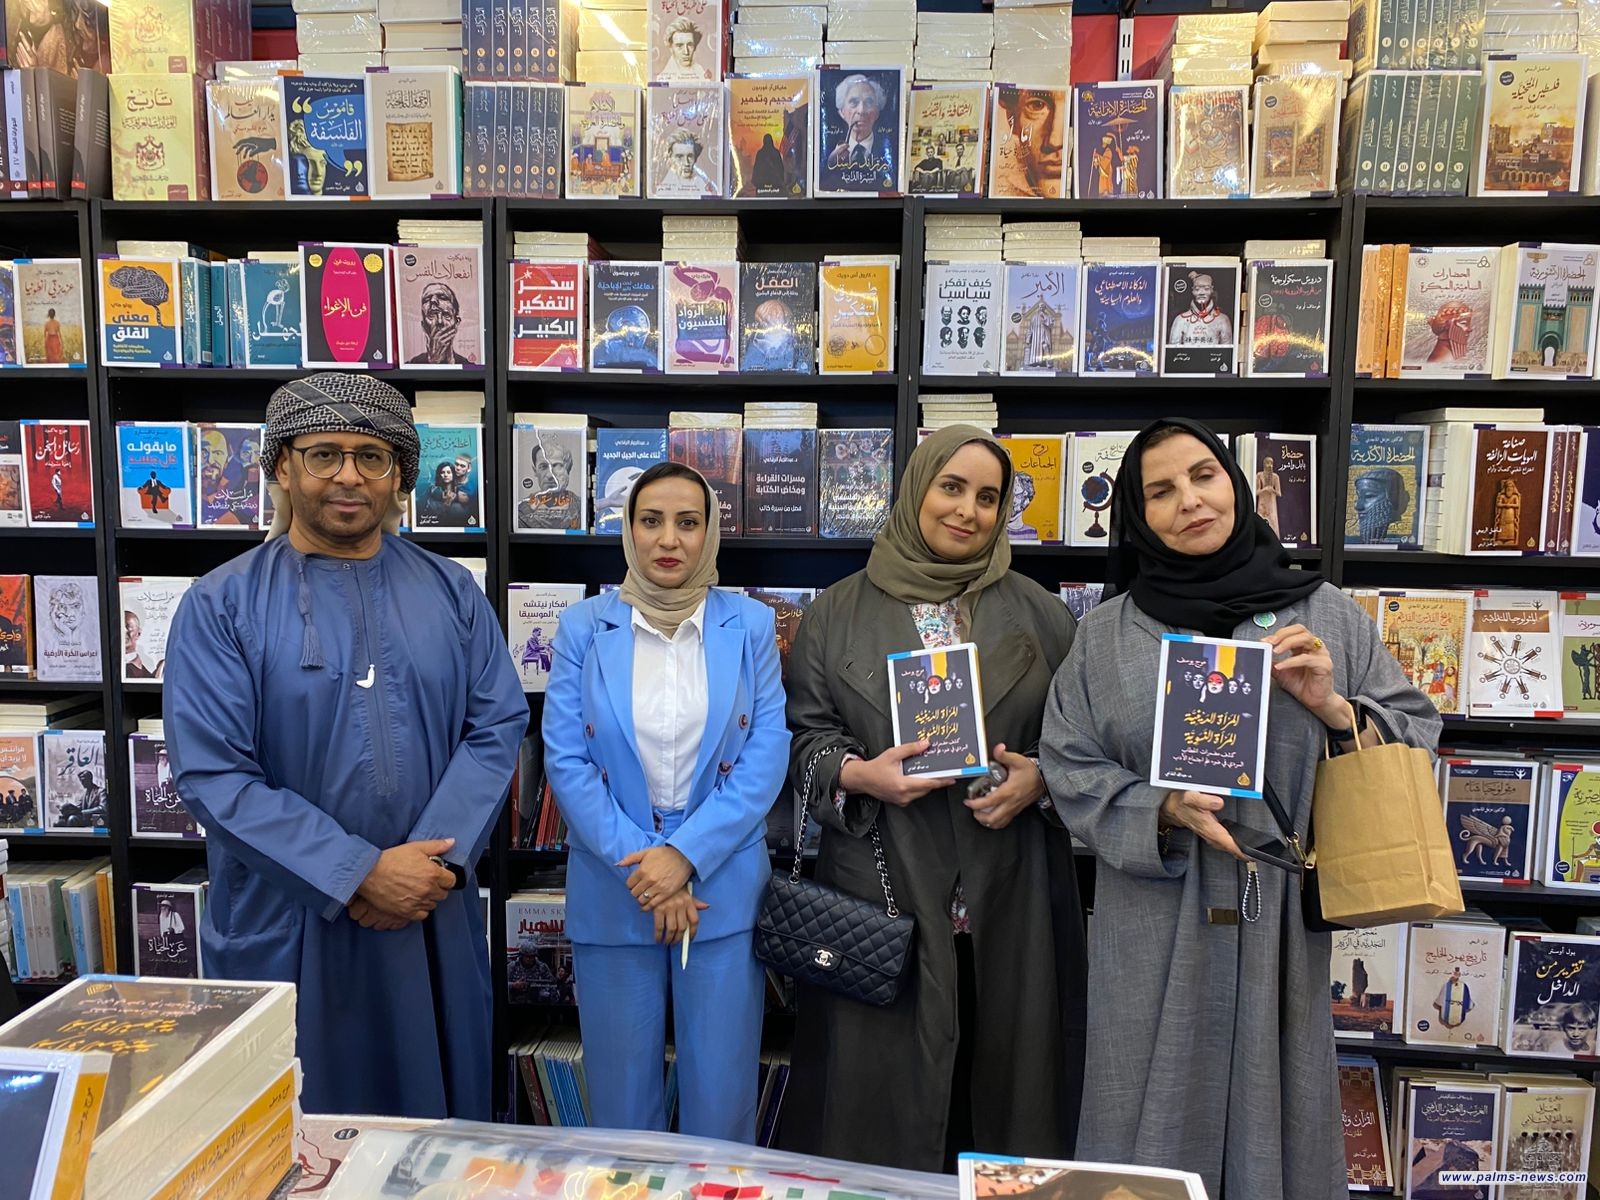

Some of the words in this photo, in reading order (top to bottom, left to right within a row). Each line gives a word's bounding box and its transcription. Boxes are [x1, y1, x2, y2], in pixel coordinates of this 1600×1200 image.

[1512, 76, 1538, 100] المتخيلة
[1527, 78, 1561, 103] فلسطين
[127, 88, 173, 112] تاريخ
[741, 95, 768, 105] وتدمير
[1119, 99, 1148, 113] الحضارة
[316, 98, 354, 119] قاموس
[311, 119, 362, 141] الفلسفة
[1300, 275, 1321, 286] دروس
[1433, 267, 1471, 281] الحضارات
[517, 279, 575, 294] سحر
[755, 277, 798, 291] العقل
[943, 278, 967, 290] تفكر
[969, 278, 992, 290] كيف
[1021, 271, 1065, 299] الأمير
[1095, 279, 1129, 295] الاصطناعي
[1129, 276, 1148, 291] الذكاء
[1420, 281, 1454, 293] المبكرة
[324, 297, 350, 317] الإغواء
[349, 303, 368, 318] فن
[517, 294, 575, 314] التفكير
[678, 305, 704, 317] الرواد
[112, 311, 149, 324] معنى
[678, 316, 726, 331] النفسيون
[112, 327, 149, 342] القلق
[517, 318, 575, 338] الكبير
[35, 436, 57, 460] السجن
[1032, 443, 1049, 456] روح
[1502, 436, 1527, 450] صناعة
[54, 441, 81, 461] رسائل
[602, 451, 621, 460] الجديد
[620, 451, 636, 460] الجيل
[635, 452, 650, 460] على
[650, 451, 661, 459] ثناء
[1281, 444, 1304, 459] حضارة
[1350, 446, 1385, 464] الأكدية
[1385, 446, 1415, 463] الحضارة
[1486, 448, 1509, 464] الزائفة
[1507, 450, 1538, 466] الهويات
[161, 454, 177, 466] كل
[1020, 456, 1056, 469] الجماعات
[756, 473, 781, 484] القراءة
[781, 475, 806, 484] مسرات
[214, 488, 253, 502] مراسلات
[756, 484, 781, 497] الكتابة
[781, 486, 806, 497] ومخاض
[137, 591, 175, 605] مراسلات
[523, 601, 548, 610] نيتشه
[549, 600, 568, 609] أفكار
[518, 610, 554, 620] الموسيقا
[44, 650, 64, 659] الأرضية
[64, 650, 80, 658] الكرة
[940, 706, 958, 723] المرأة
[1216, 712, 1240, 731] المرأة
[917, 724, 941, 740] النسوية
[940, 722, 958, 739] المرأة
[1184, 729, 1214, 745] النسوية
[1213, 731, 1237, 750] المرأة
[145, 786, 168, 805] الحياة
[518, 907, 546, 915] EMMA
[147, 936, 170, 955] الحياة
[167, 940, 187, 958] عن
[1548, 947, 1566, 957] أوستر
[1425, 947, 1448, 964] الخليج
[1446, 952, 1466, 964] يهود
[1464, 950, 1487, 966] تاريخ
[1565, 949, 1576, 959] بول
[1535, 962, 1557, 979] من
[1554, 960, 1585, 978] تقرير
[1537, 979, 1581, 1005] الداخل
[1420, 1102, 1443, 1116] الذهبي
[1442, 1102, 1471, 1117] والغصن
[1469, 1103, 1489, 1118] العرب
[1351, 1109, 1376, 1128] القرآن
